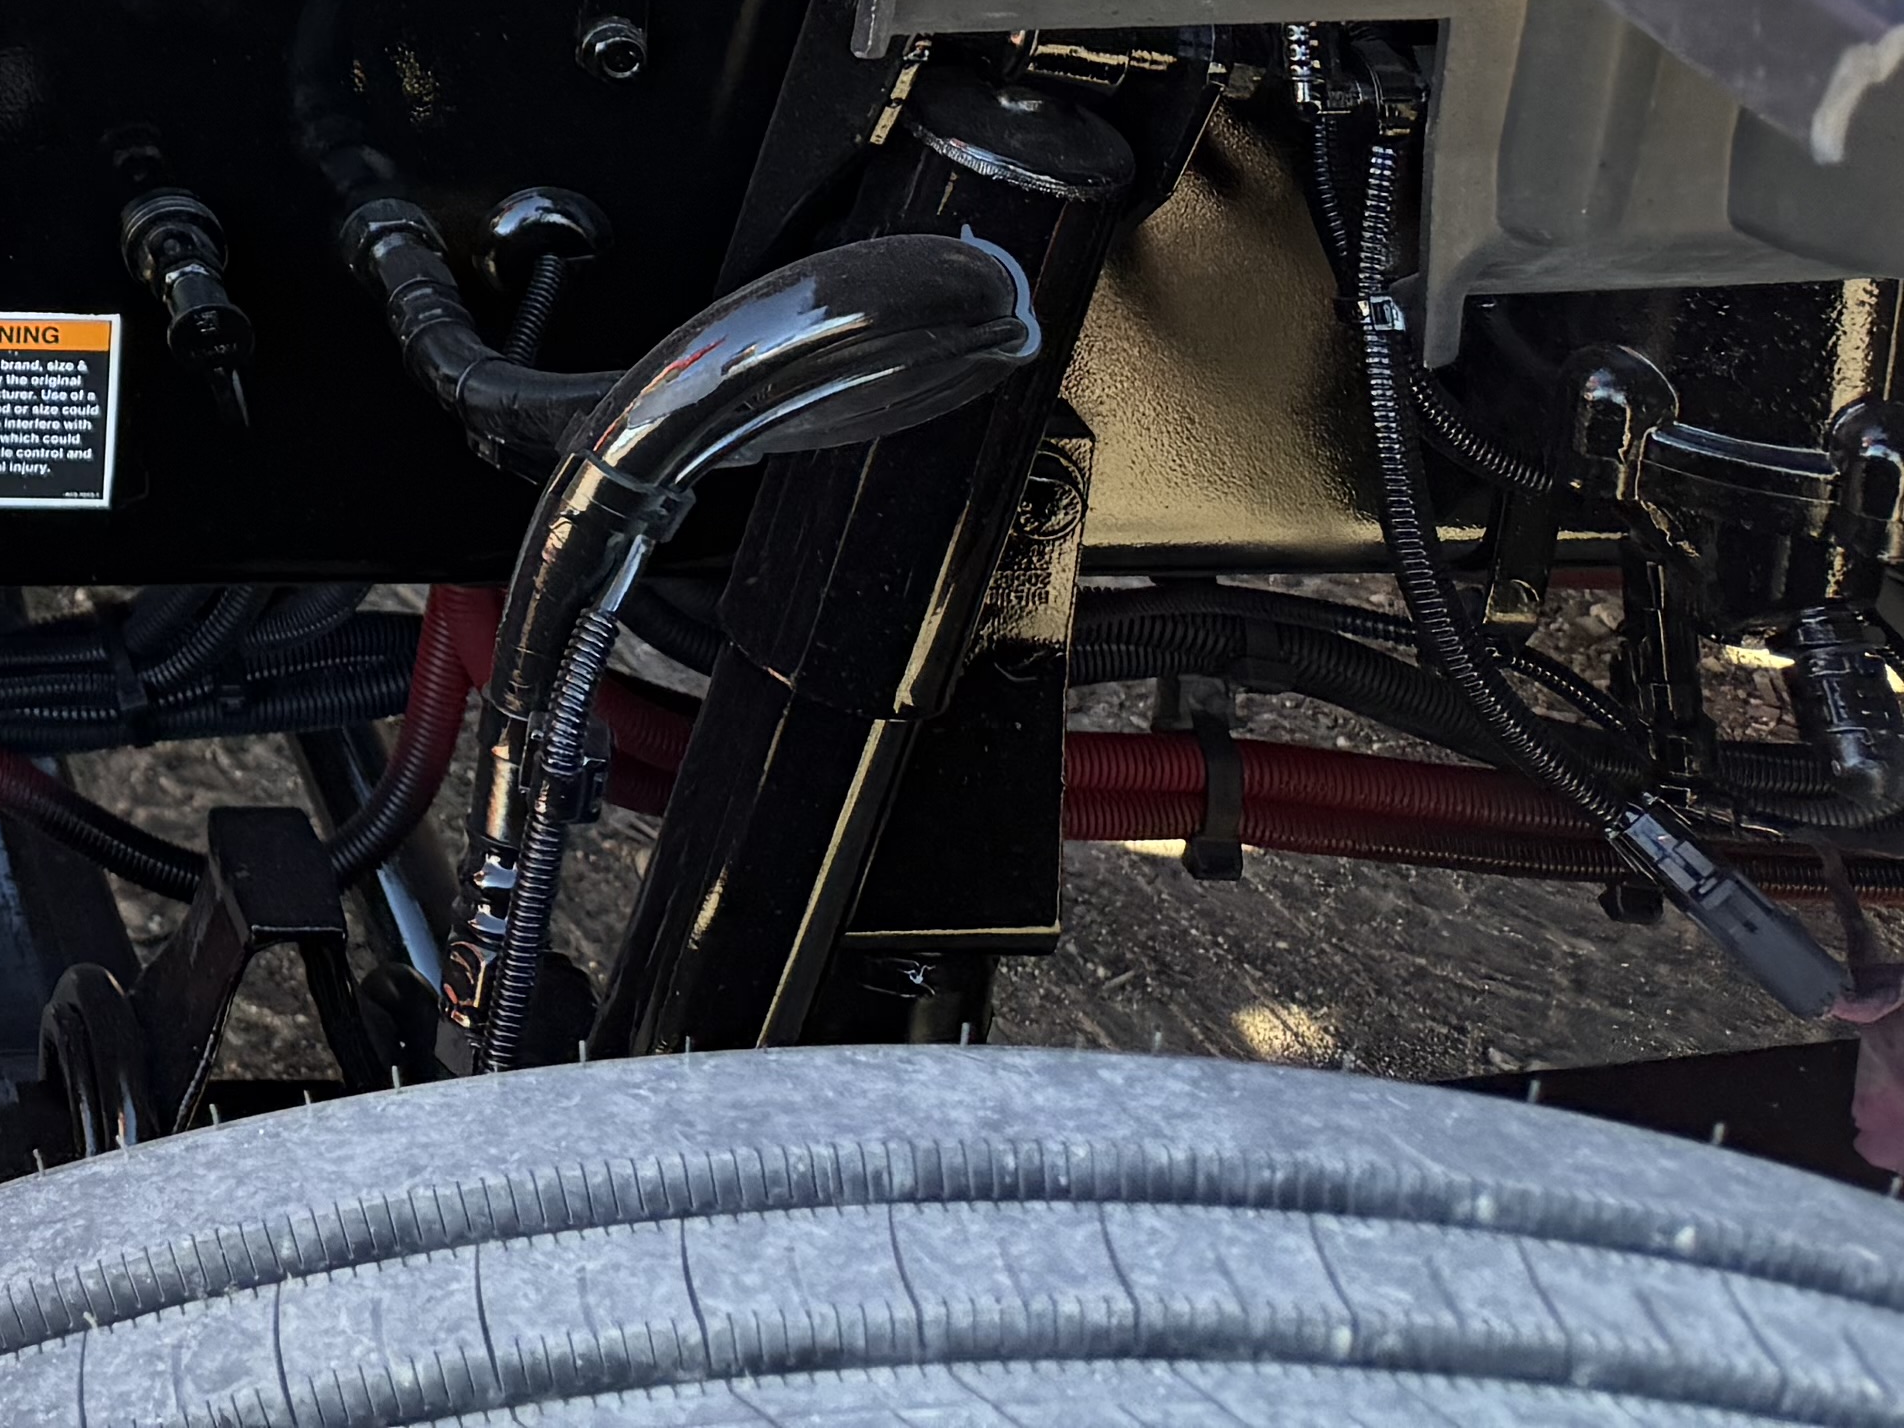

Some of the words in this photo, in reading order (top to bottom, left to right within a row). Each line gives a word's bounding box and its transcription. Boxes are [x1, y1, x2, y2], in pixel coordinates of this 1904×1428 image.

[46, 359, 74, 372] size
[5, 373, 29, 386] the
[30, 374, 82, 388] original
[40, 388, 68, 402] Use
[69, 389, 85, 401] of
[13, 404, 30, 415] or
[31, 403, 60, 416] size
[61, 404, 101, 417] could
[3, 417, 62, 431] interfere
[63, 418, 93, 431] with
[0, 432, 40, 444] which
[42, 433, 82, 446] could
[15, 447, 65, 460] control
[66, 447, 93, 460] and
[9, 461, 52, 476] injury.
